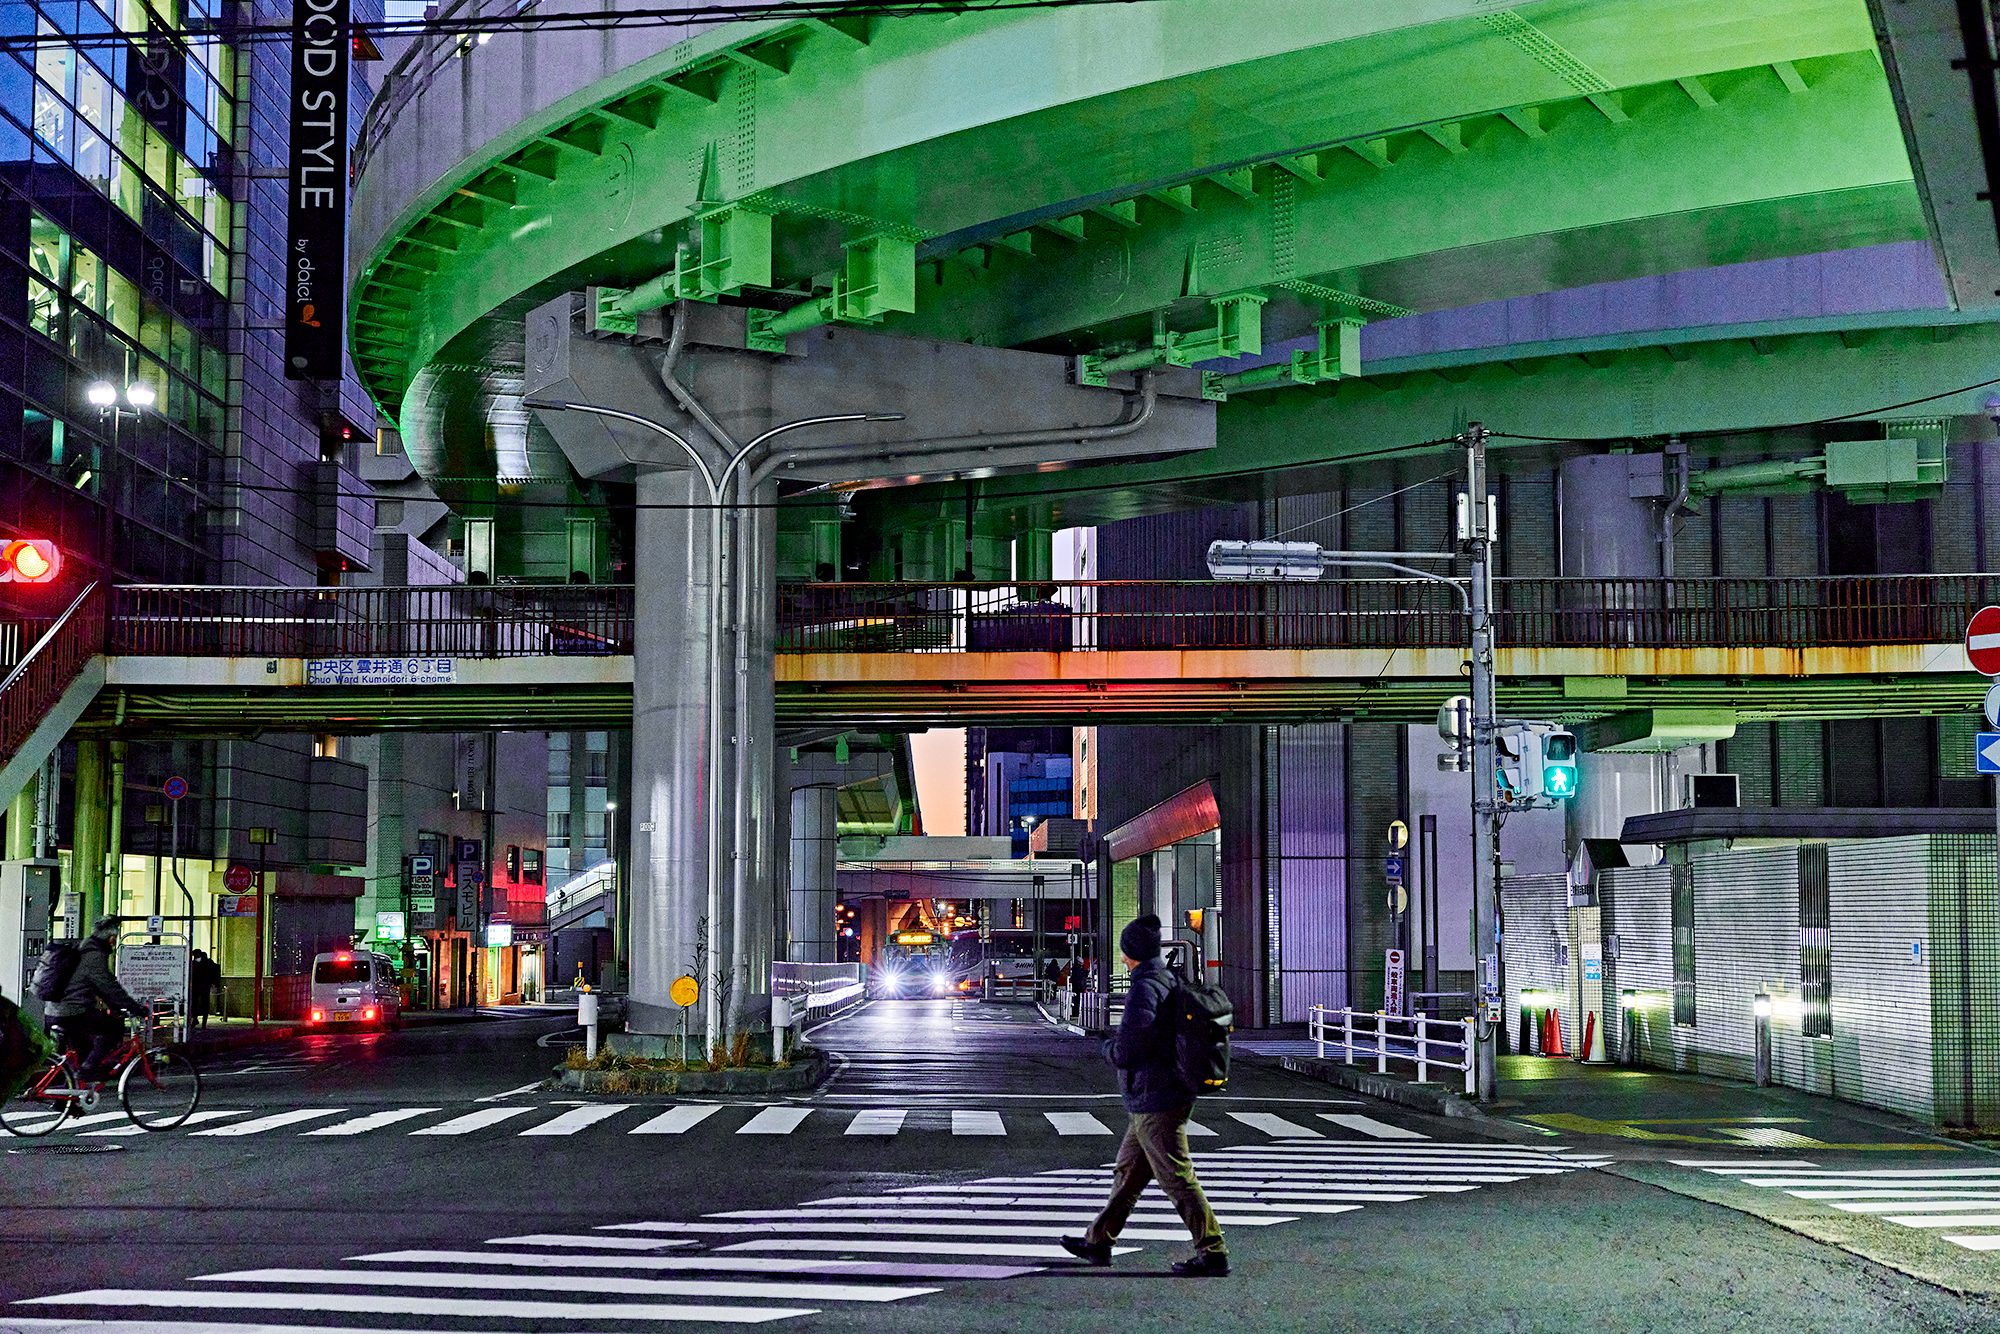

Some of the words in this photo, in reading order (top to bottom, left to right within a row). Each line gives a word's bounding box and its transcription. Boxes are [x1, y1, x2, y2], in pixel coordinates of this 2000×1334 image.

[301, 89, 336, 208] STYLE
[295, 239, 309, 253] by
[297, 257, 316, 303] daiei
[308, 676, 331, 684] Chuo
[335, 675, 359, 684] Ward
[362, 674, 408, 683] Kumoidori
[463, 844, 475, 859] P
[412, 858, 431, 874] P
[461, 867, 474, 928] コスモビル
